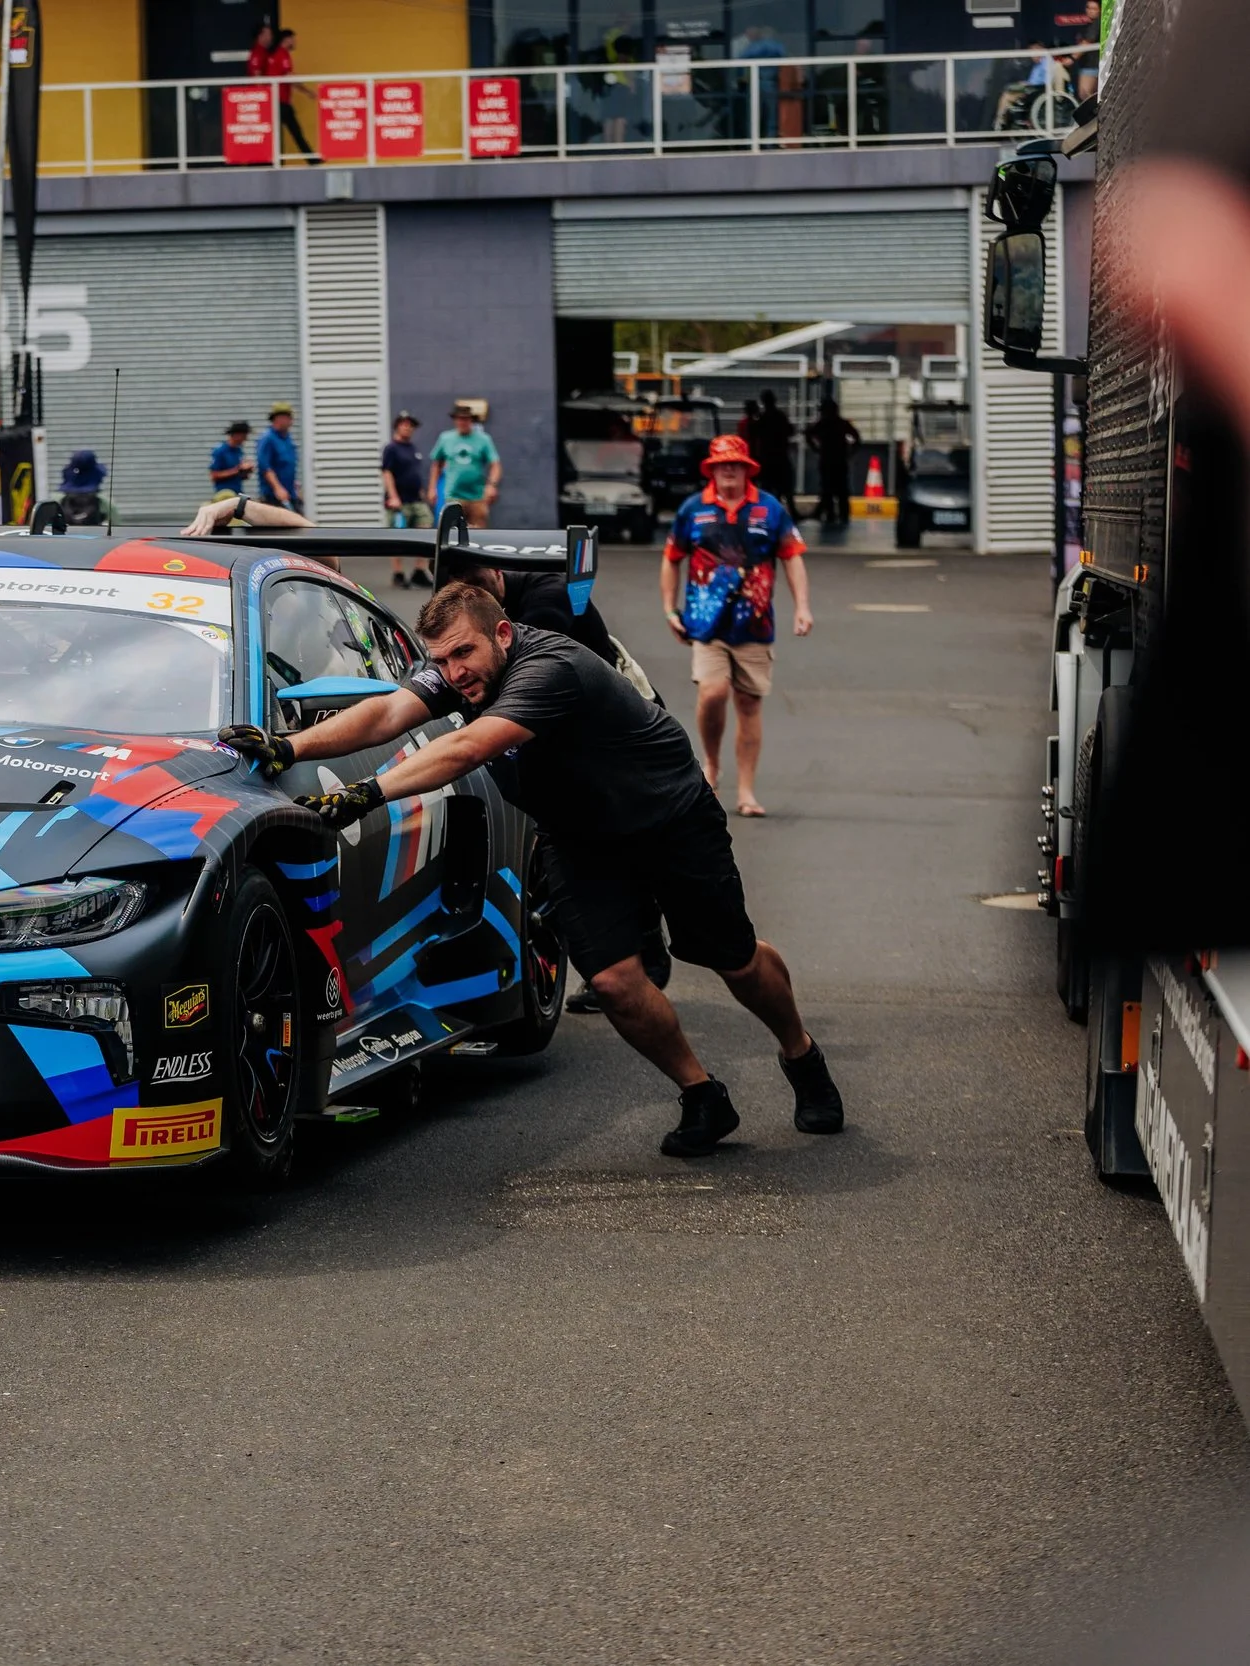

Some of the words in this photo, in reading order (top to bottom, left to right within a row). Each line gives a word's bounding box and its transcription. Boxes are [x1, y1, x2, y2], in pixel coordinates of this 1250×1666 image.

[146, 592, 206, 615] 32
[167, 988, 206, 1023] Meguiar's
[152, 1051, 213, 1081] ENDLESS
[123, 1110, 216, 1147] PIRELLI
